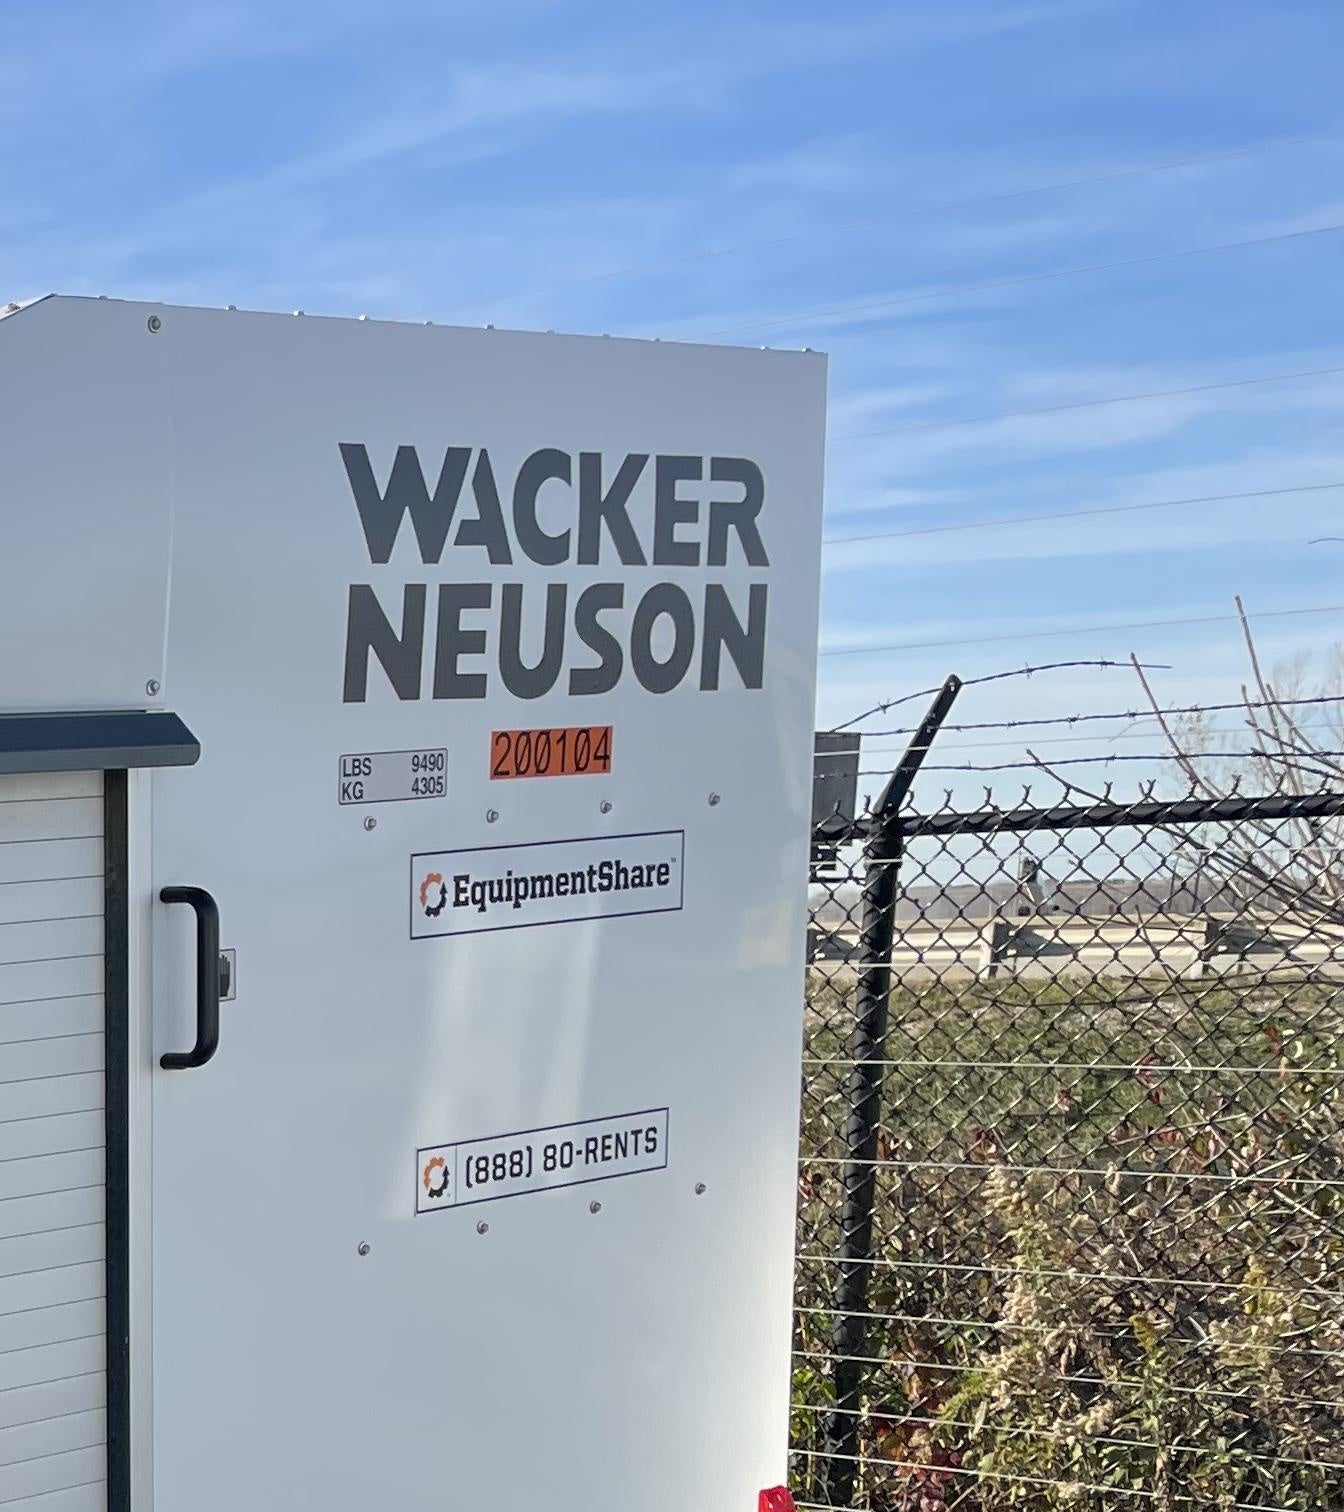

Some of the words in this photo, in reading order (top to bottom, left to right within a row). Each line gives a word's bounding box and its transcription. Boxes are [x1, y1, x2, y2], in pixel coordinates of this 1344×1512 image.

[338, 442, 771, 567] WACKER
[342, 582, 769, 704] NEUSON
[343, 757, 372, 777] LBS
[412, 753, 445, 773] 9490
[493, 728, 610, 777] 200104
[342, 781, 363, 800] KG
[411, 776, 444, 795] 4305
[453, 860, 670, 912] EquipmentShare
[466, 1146, 533, 1188] (888)
[543, 1126, 658, 1172] 80-RENTS
